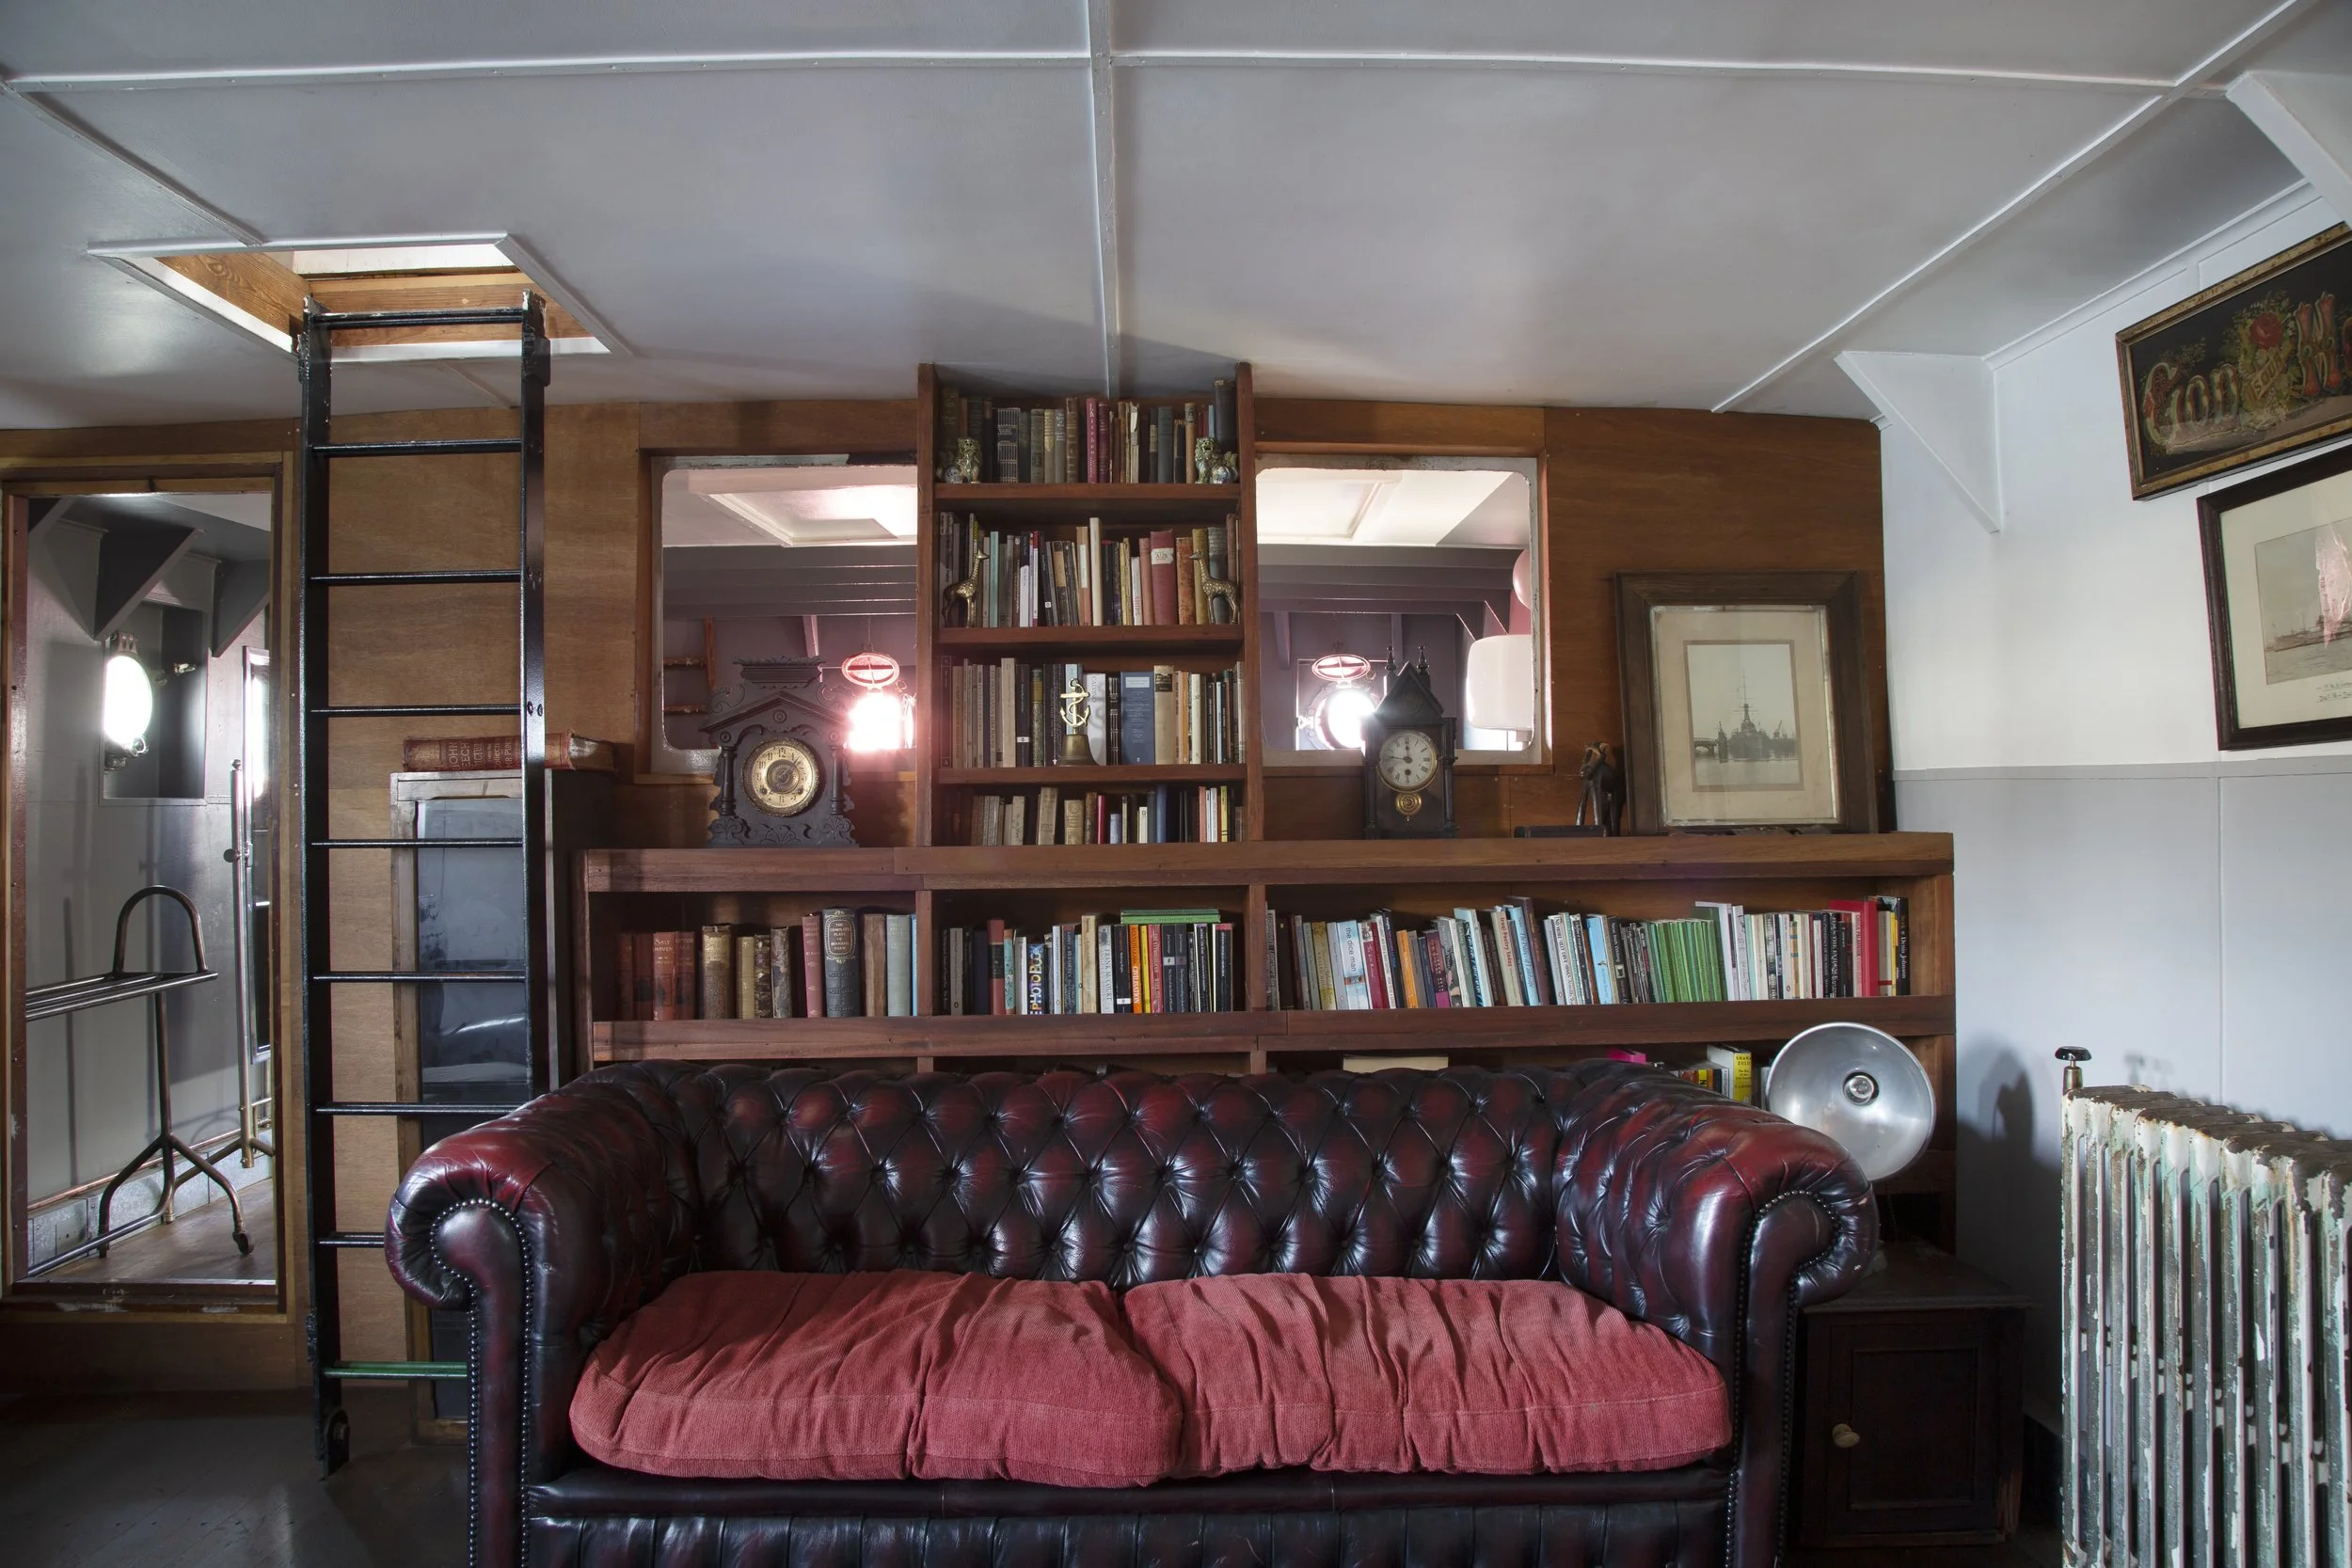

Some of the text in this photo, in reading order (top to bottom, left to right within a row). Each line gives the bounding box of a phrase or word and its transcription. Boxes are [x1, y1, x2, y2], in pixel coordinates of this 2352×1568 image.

[449, 741, 460, 768] JOHN
[1899, 954, 1908, 979] Johnson
[1132, 966, 1140, 1005] CIVILISATION
